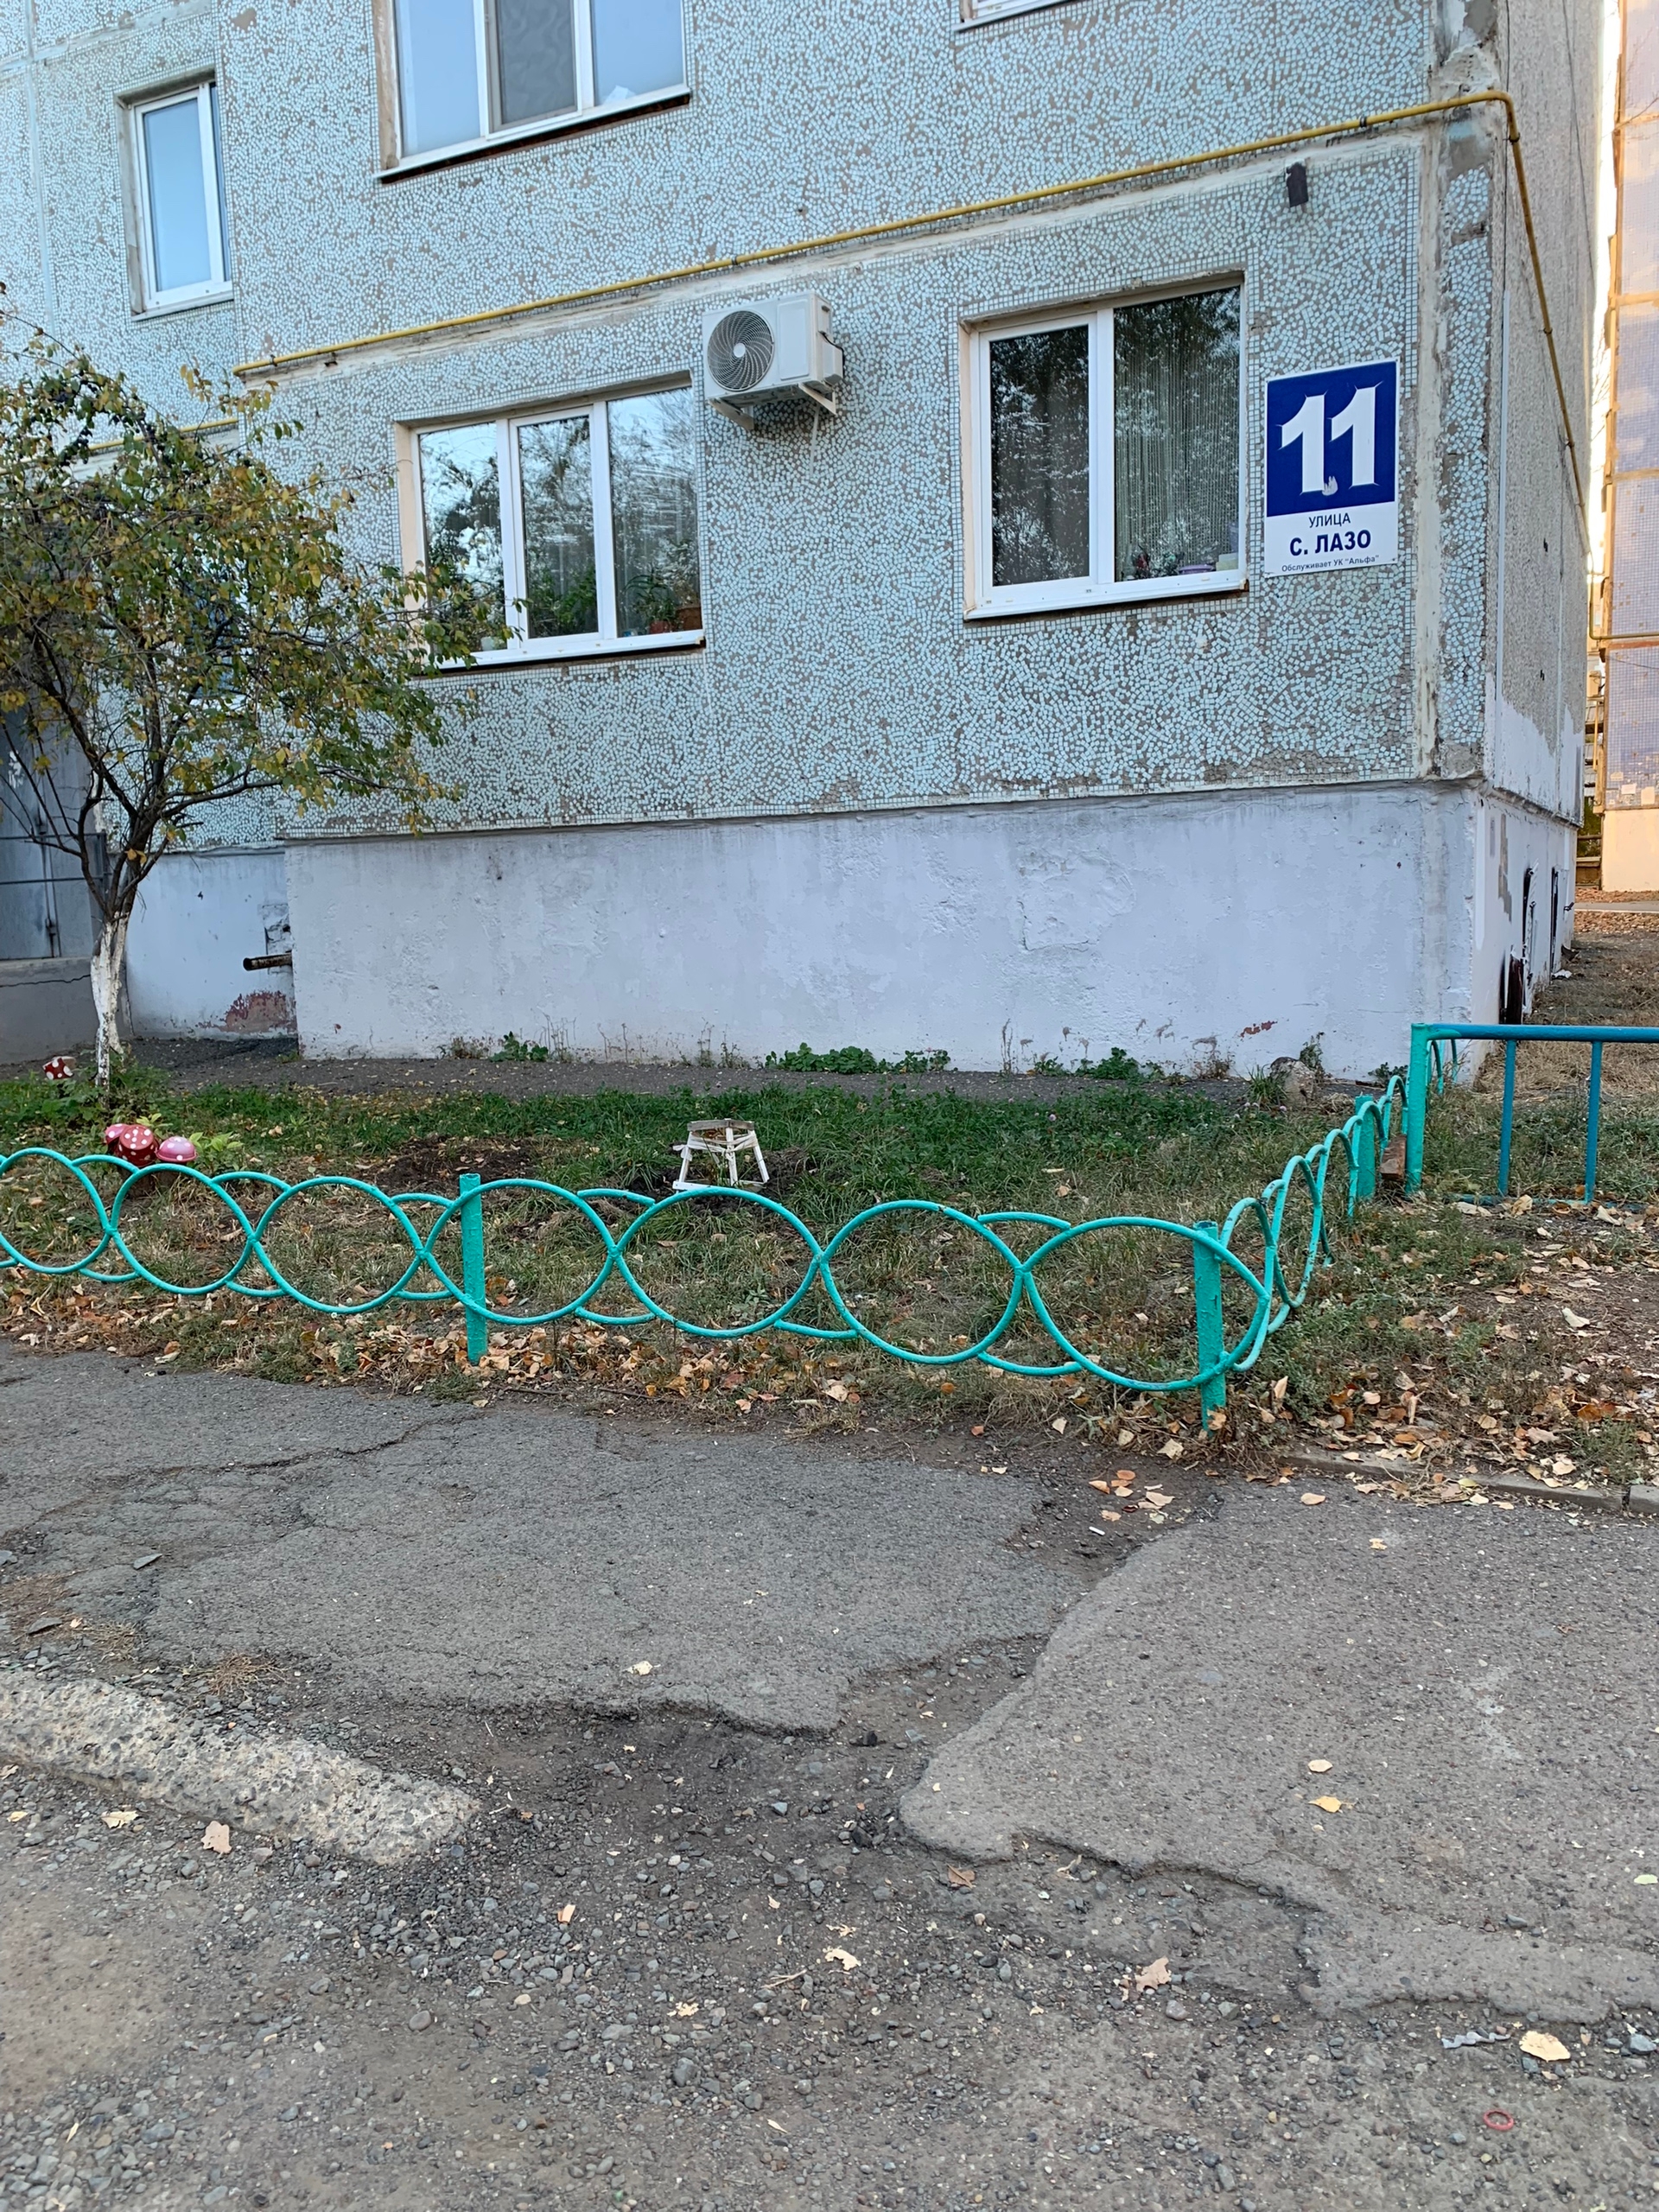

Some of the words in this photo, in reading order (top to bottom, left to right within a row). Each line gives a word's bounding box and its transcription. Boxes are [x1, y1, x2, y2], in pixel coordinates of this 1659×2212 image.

[1279, 384, 1379, 493] 11
[1309, 512, 1351, 528] УЛИЦА
[1289, 537, 1308, 556] С.
[1314, 529, 1371, 554] ЛАЗО
[1281, 561, 1332, 572] Обслуживает
